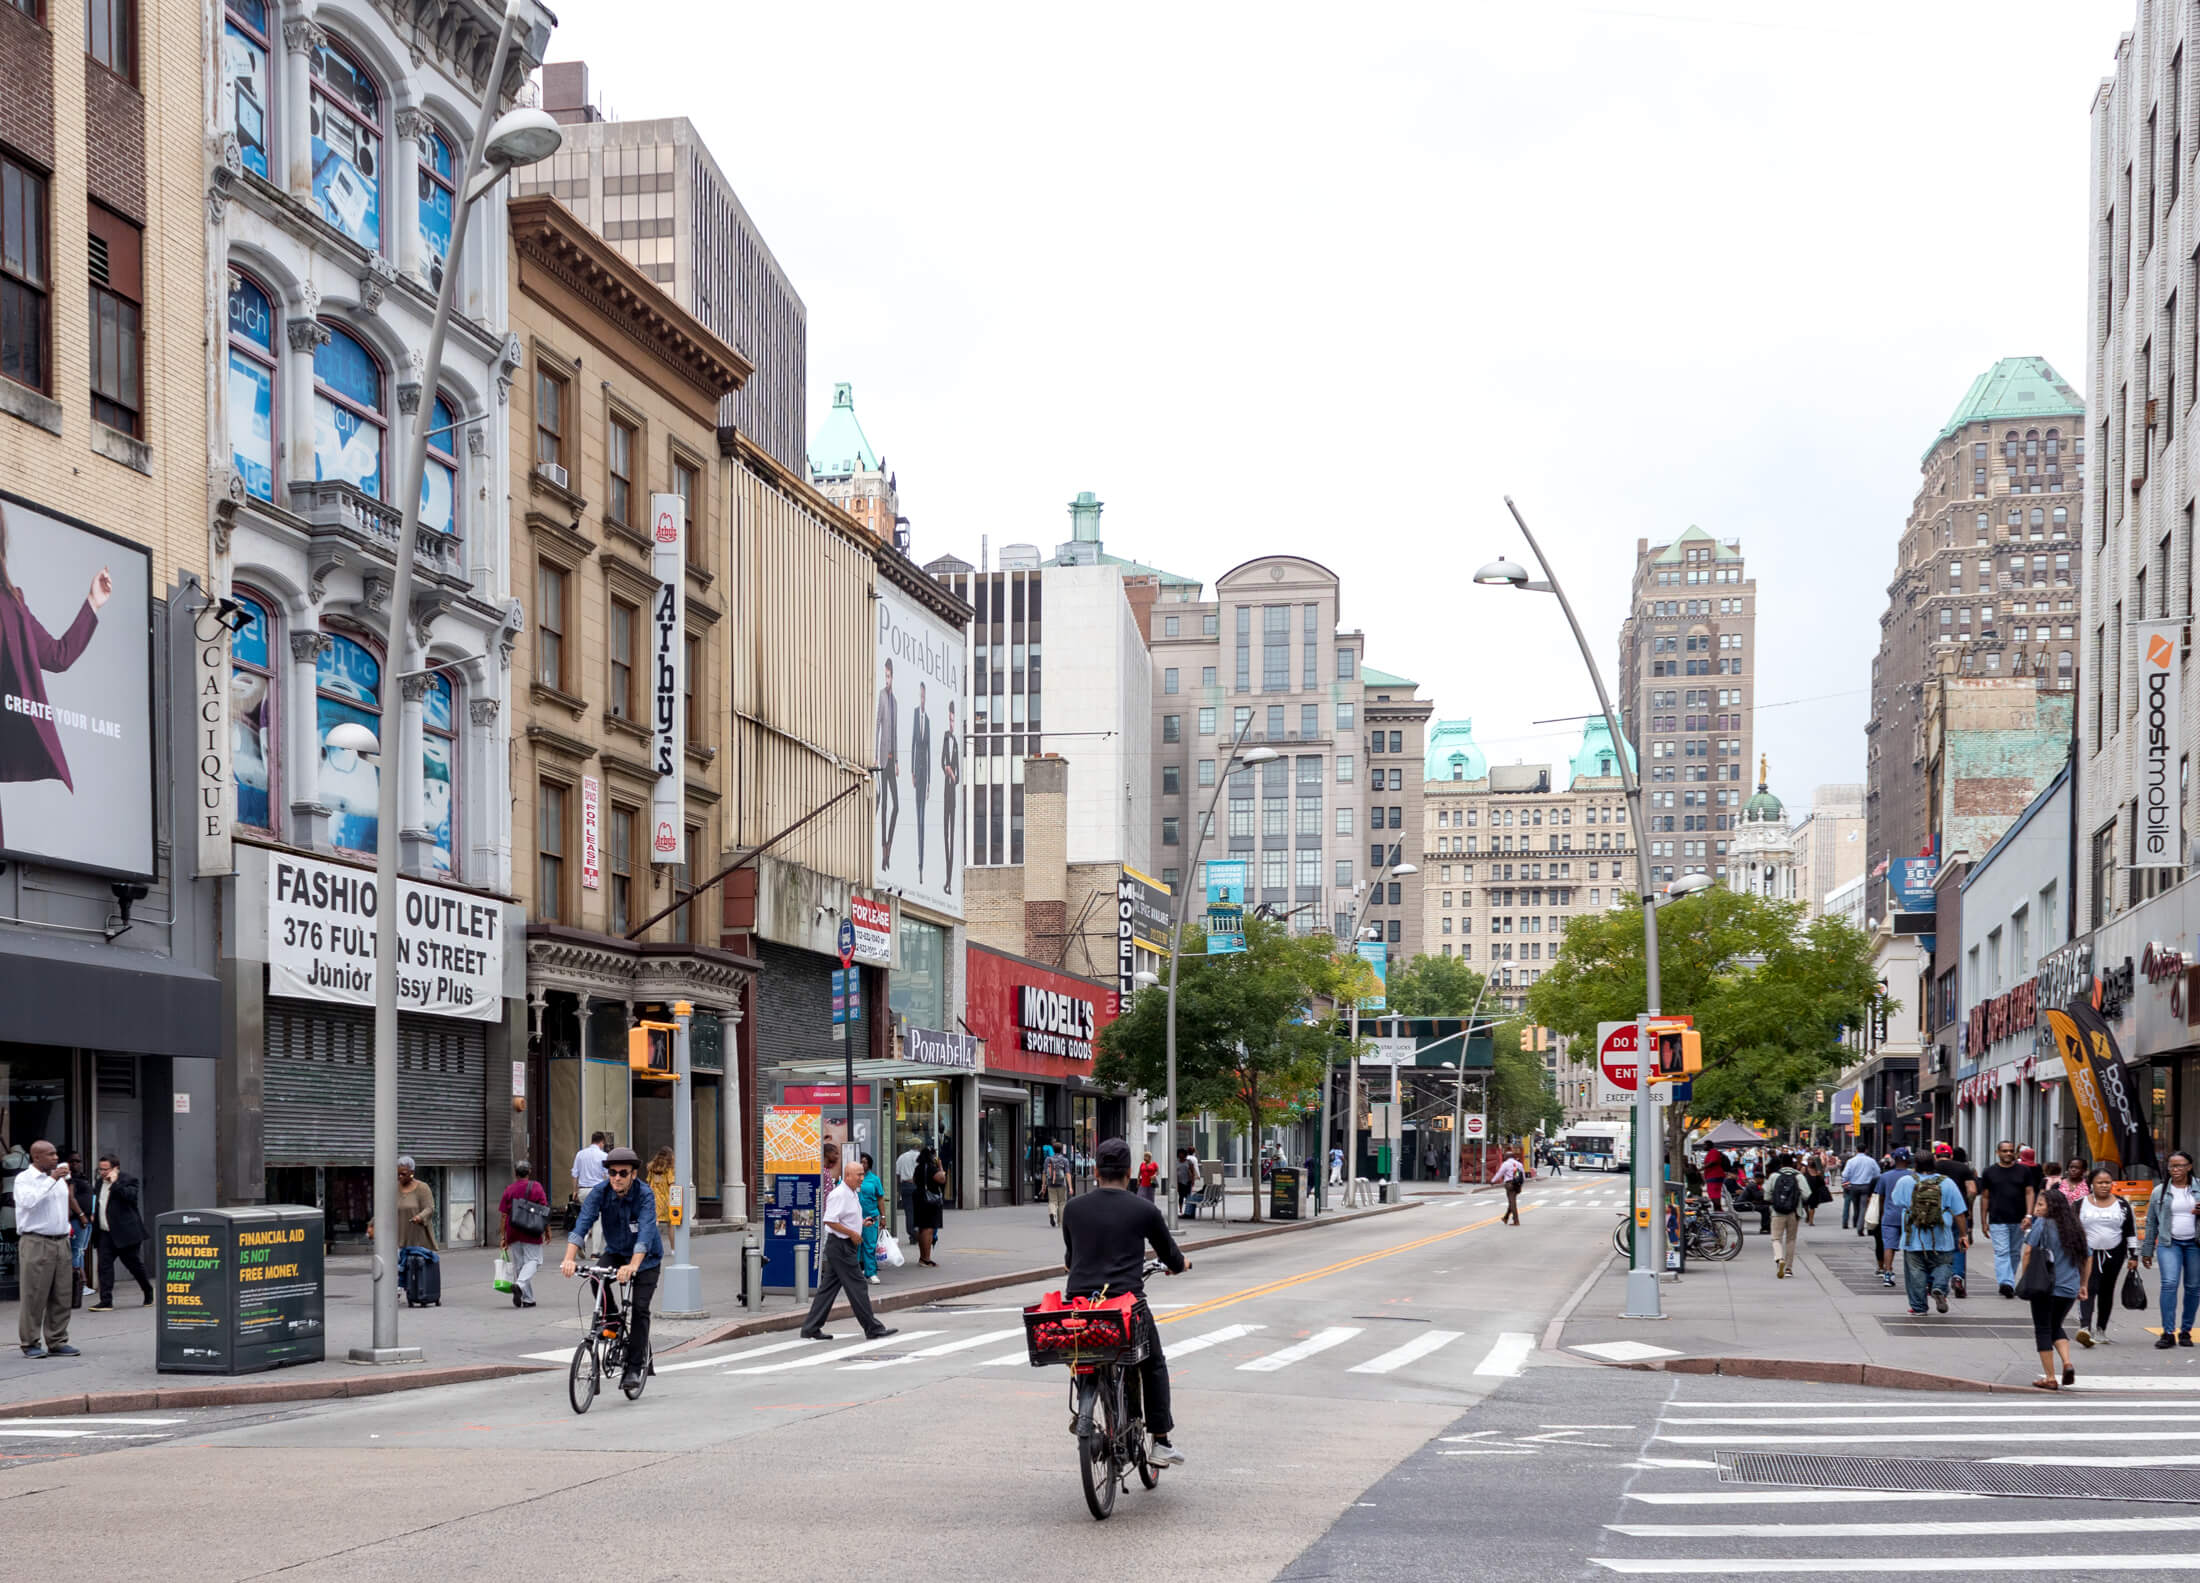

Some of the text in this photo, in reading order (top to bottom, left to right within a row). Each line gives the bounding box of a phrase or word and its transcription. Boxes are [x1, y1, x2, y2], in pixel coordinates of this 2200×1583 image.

[656, 584, 677, 777] Arby's
[4, 693, 121, 739] CREATE YOUR LANE
[201, 646, 223, 837] CACIQUE
[586, 804, 596, 828] FOR
[586, 829, 596, 867] LEASE
[277, 862, 498, 941] FASHIO OUTLET
[852, 903, 890, 928] FOR LEASE
[284, 917, 487, 977] 376 FULTN STREET
[1118, 882, 1133, 1014] MODELLS
[307, 958, 473, 1007] Junior issy Plus
[1024, 985, 1095, 1041] MODELL'S
[1027, 1031, 1092, 1061] SPORTING GOODS
[1613, 1037, 1657, 1048] DO NT
[1606, 1093, 1636, 1102] EXCEPT
[2080, 1067, 2109, 1134] boost
[2098, 1070, 2117, 1107] mobile
[2106, 1062, 2139, 1136] boost
[166, 1234, 211, 1245] STUDENT
[239, 1228, 305, 1247] FINANCIAL AID
[166, 1246, 219, 1257] LOAN DEBT
[167, 1259, 220, 1270] SHOULDN'T
[240, 1248, 271, 1265] IS NOT
[167, 1271, 196, 1281] MEAN
[239, 1264, 299, 1282] FREE MONEY.
[166, 1283, 192, 1293] DEBT
[166, 1295, 204, 1306] STRESS.
